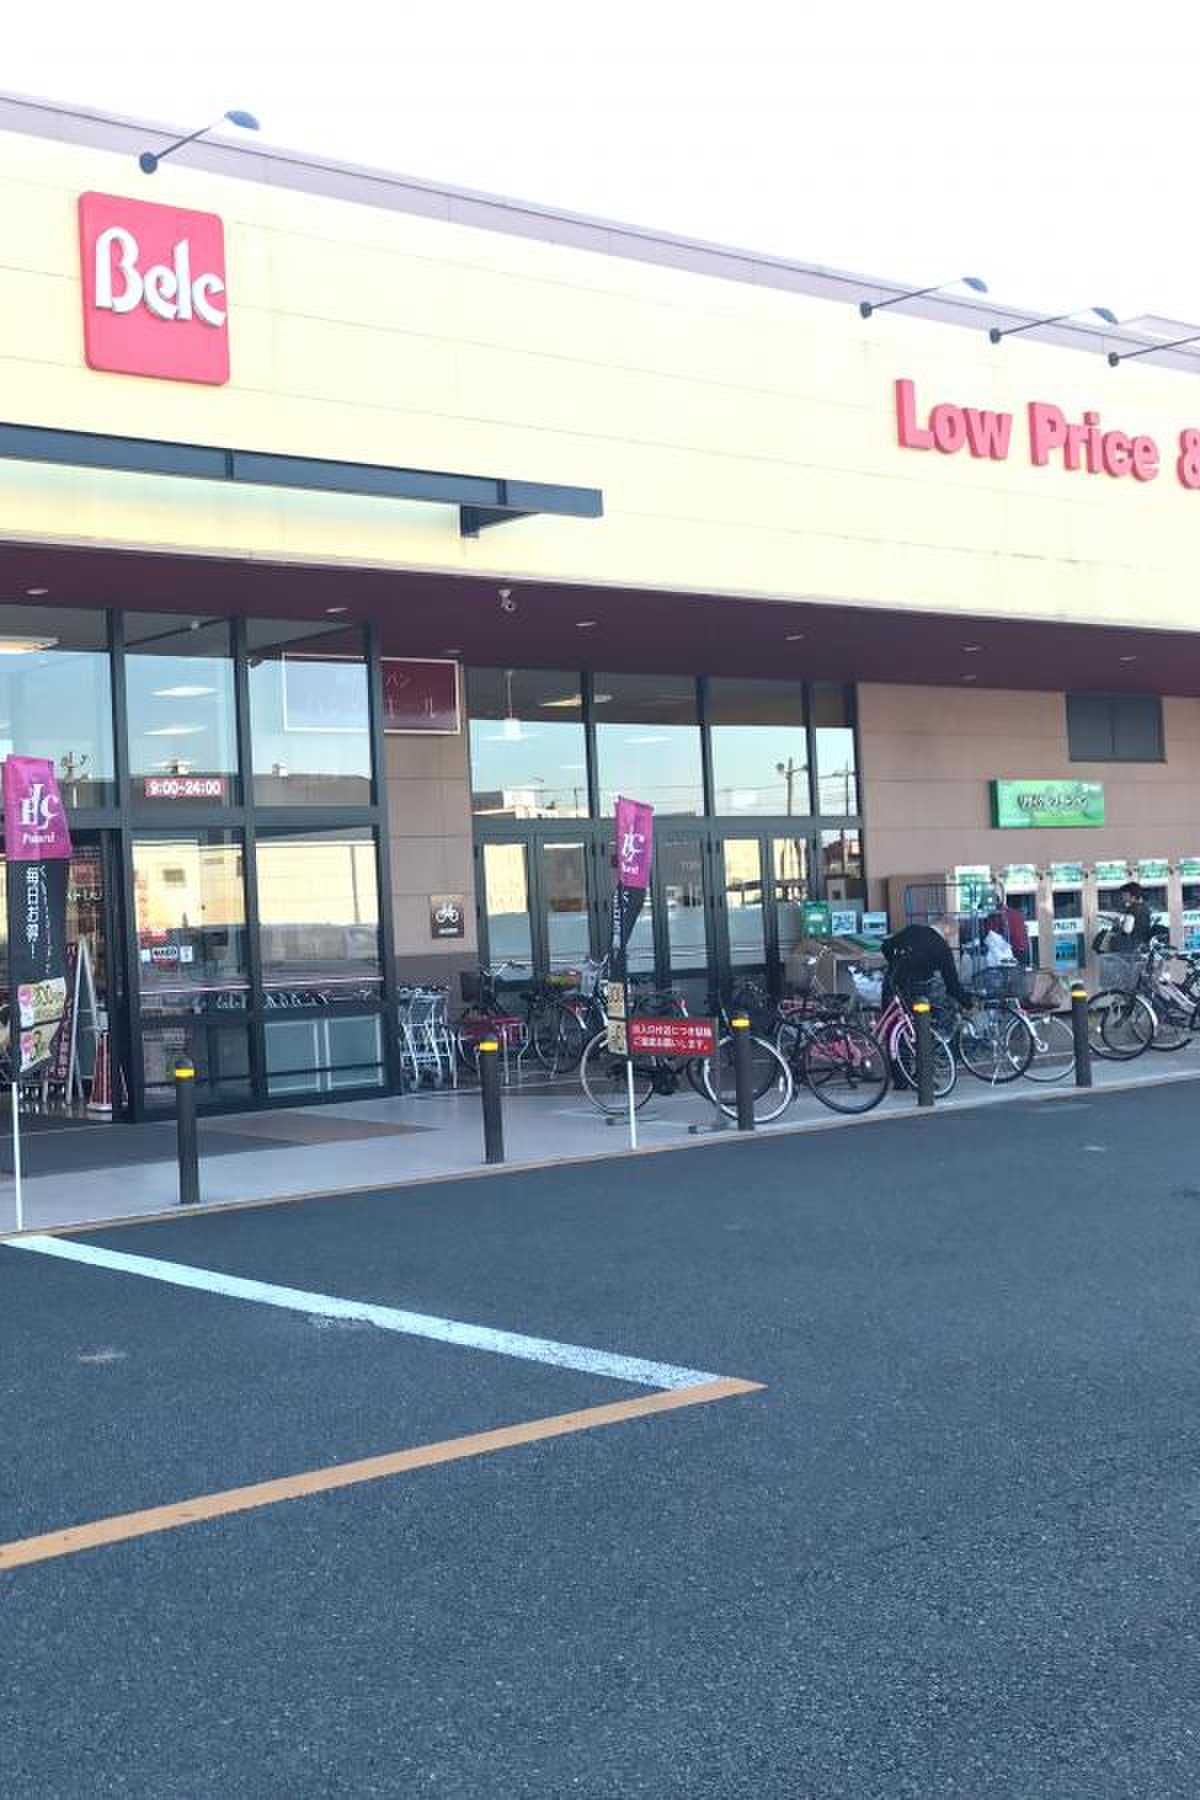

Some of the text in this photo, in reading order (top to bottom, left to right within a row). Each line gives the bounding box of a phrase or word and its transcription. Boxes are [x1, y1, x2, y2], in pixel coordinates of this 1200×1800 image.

[95, 226, 227, 328] Belc
[894, 379, 1013, 460] Low
[1028, 401, 1160, 482] Price
